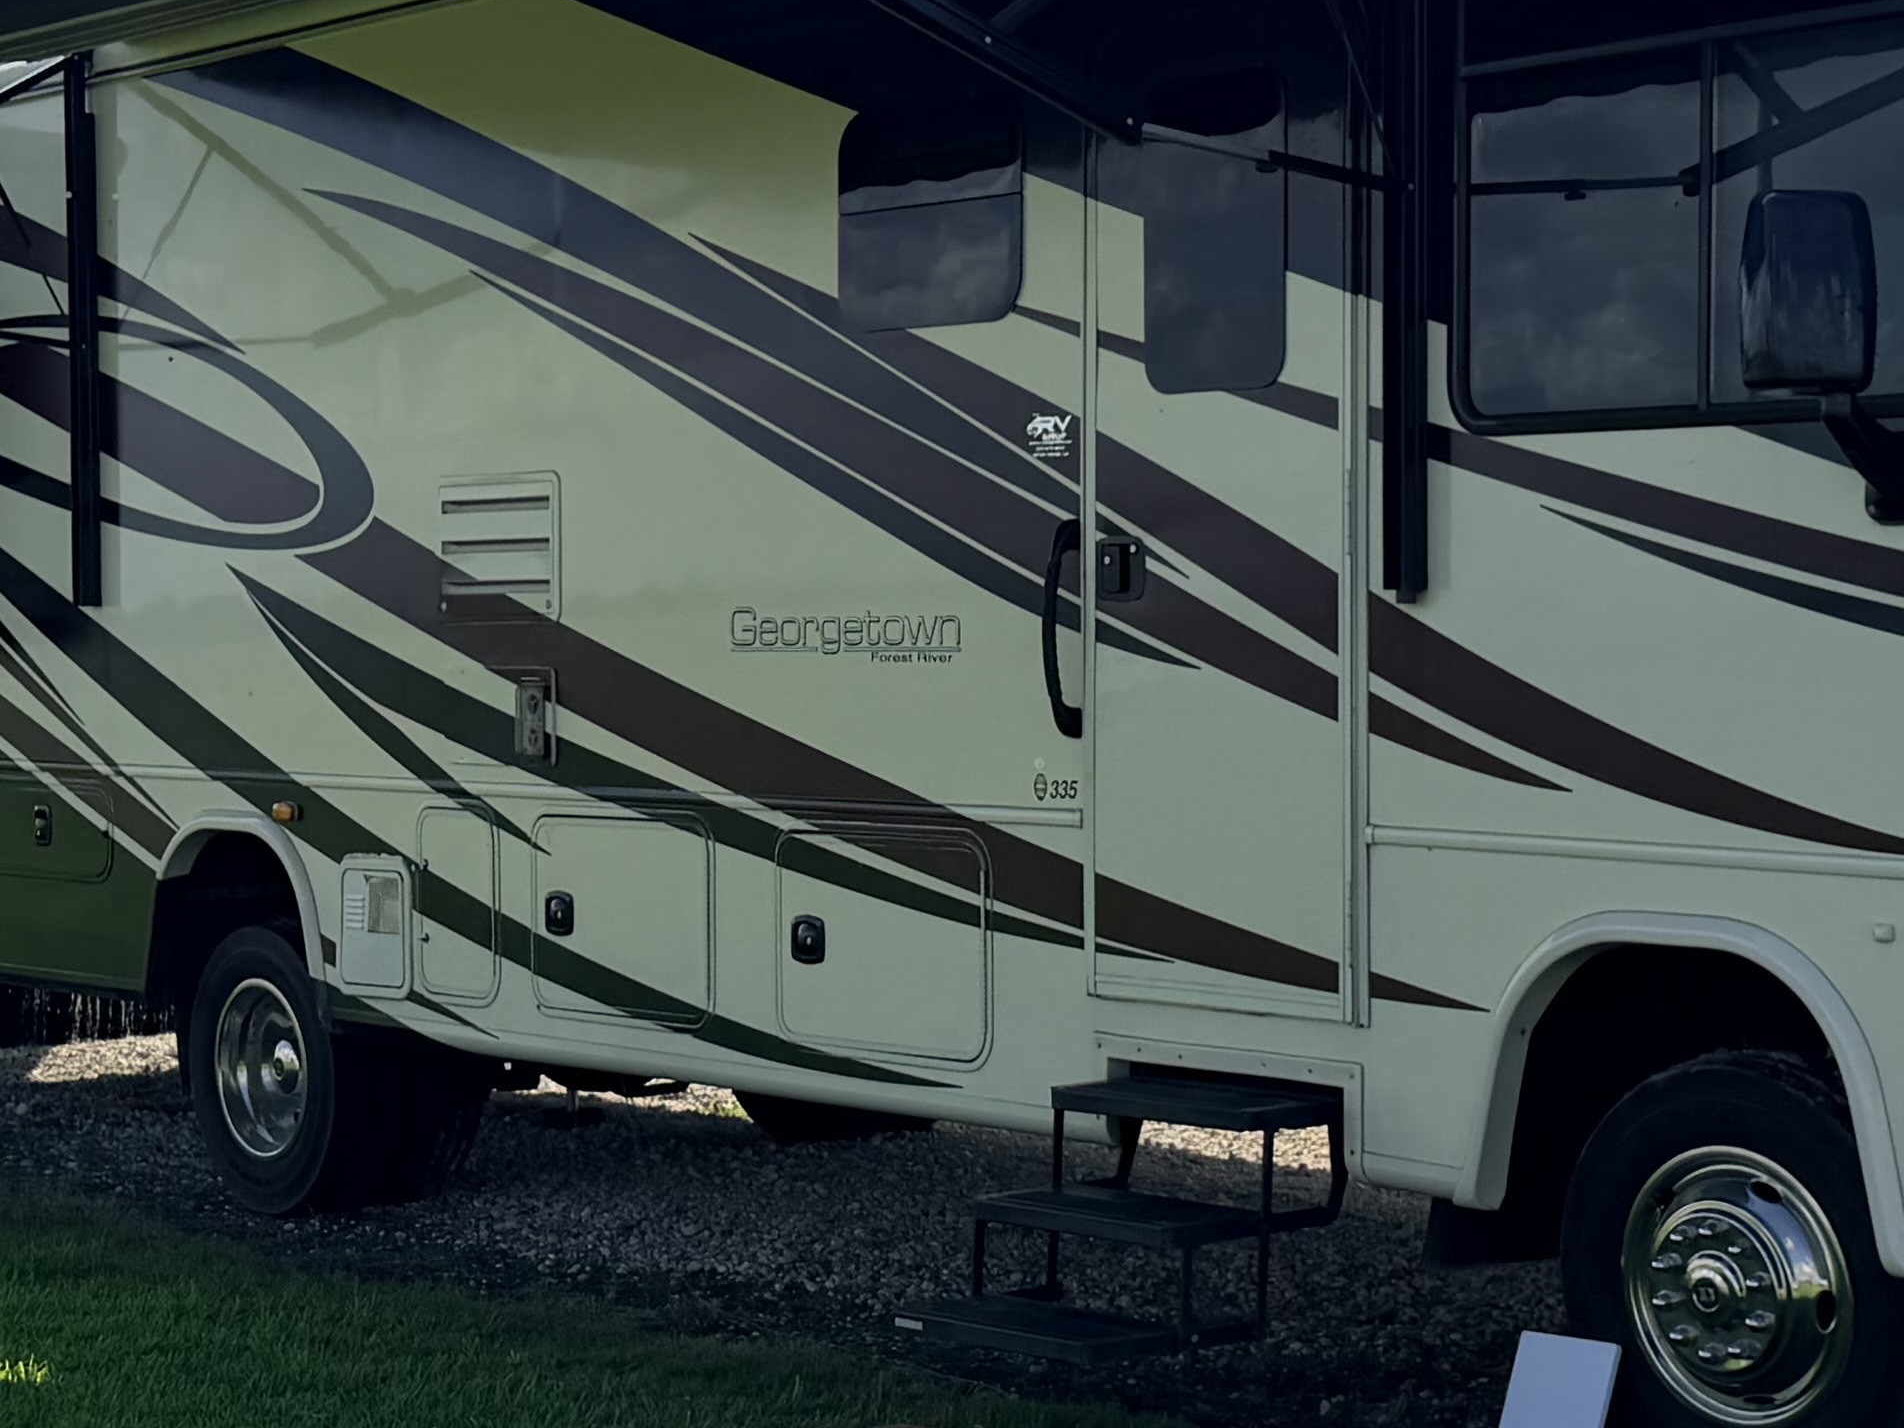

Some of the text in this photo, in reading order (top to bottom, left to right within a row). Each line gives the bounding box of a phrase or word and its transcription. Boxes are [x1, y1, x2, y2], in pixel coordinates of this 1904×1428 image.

[730, 606, 962, 655] Georgetown
[870, 651, 953, 664] Forest River
[1049, 779, 1079, 800] 335
